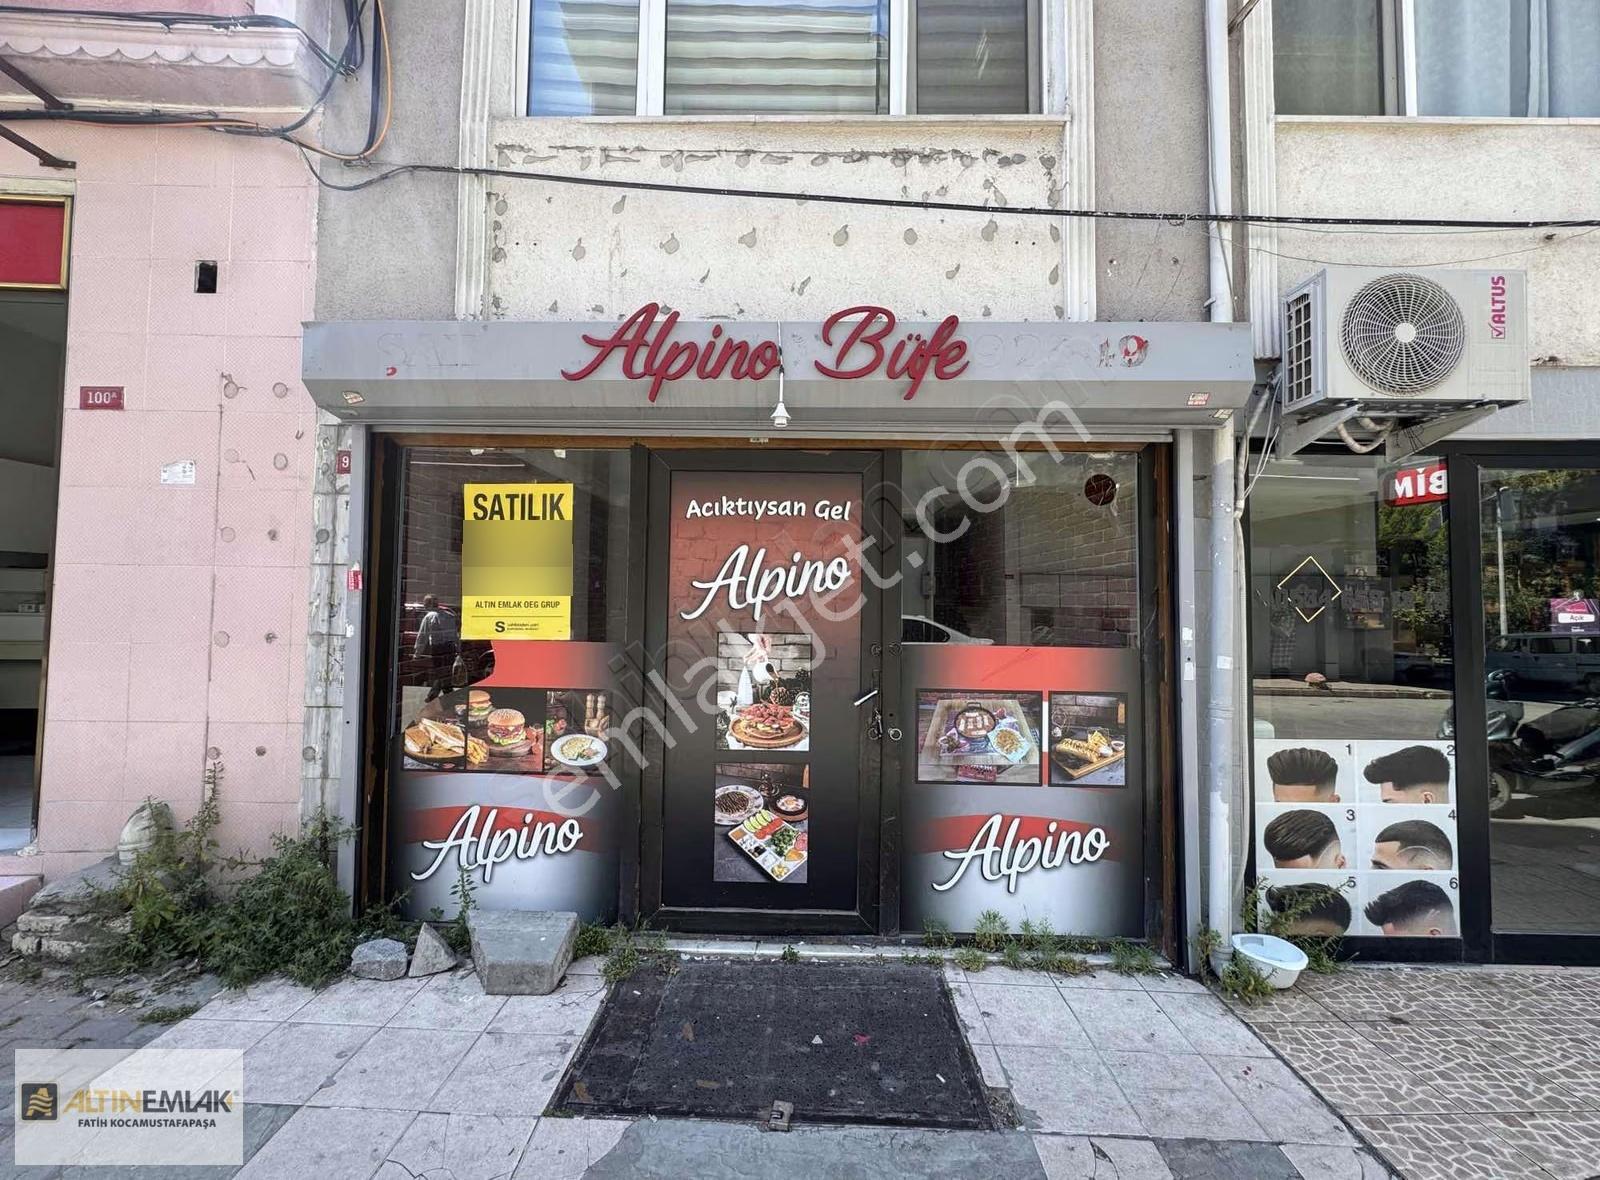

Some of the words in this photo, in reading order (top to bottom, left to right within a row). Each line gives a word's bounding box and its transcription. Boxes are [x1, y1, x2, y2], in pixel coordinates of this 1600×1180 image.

[1491, 275, 1506, 325] ALTUS
[560, 302, 782, 403] Alpino
[814, 305, 970, 400] Büfe
[473, 493, 565, 521] SATILIK
[685, 495, 807, 521] Acıktıysan
[814, 500, 852, 521] Gel
[680, 544, 852, 623] Alpino
[475, 600, 496, 609] ALTIN
[498, 600, 522, 609] EMLAK
[541, 601, 561, 609] GRUP
[1345, 744, 1353, 756] 1
[1446, 744, 1456, 756] 2
[1346, 809, 1356, 821] 3
[1448, 809, 1457, 821] 4
[410, 804, 584, 884] Alpino
[931, 813, 1111, 894] Alpino
[1346, 876, 1357, 889] 5
[1449, 876, 1459, 889] 6
